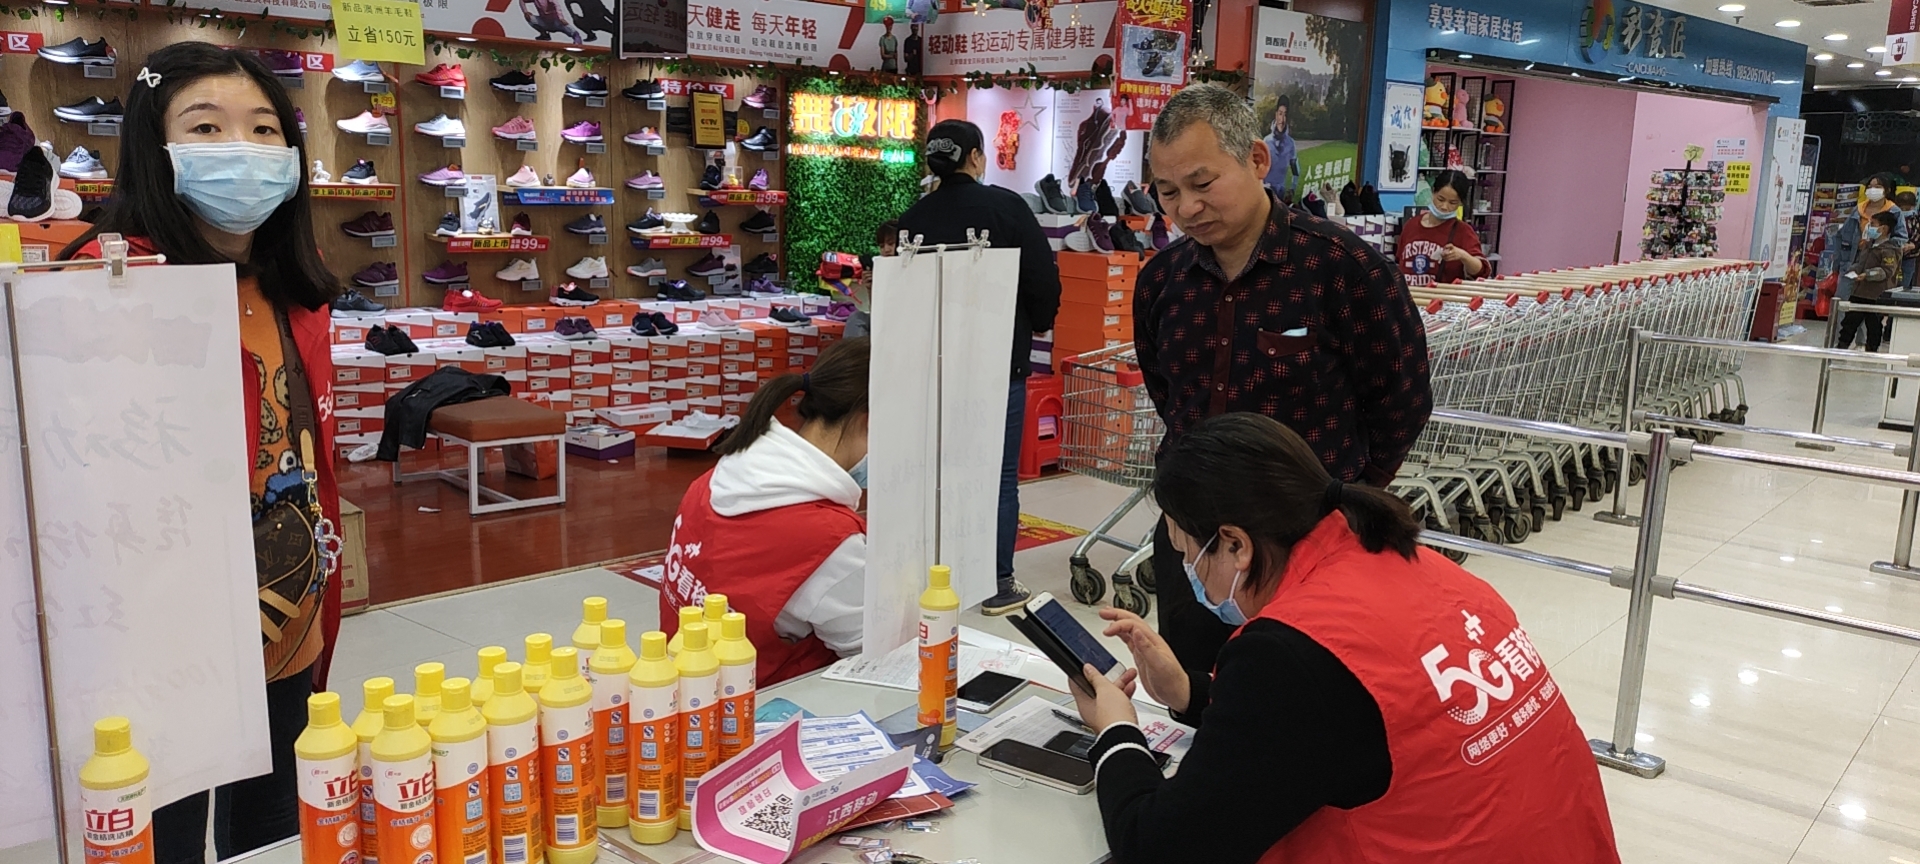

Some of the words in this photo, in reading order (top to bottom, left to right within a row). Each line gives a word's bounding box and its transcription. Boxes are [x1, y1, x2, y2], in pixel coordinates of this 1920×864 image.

[688, 4, 741, 31] 天健走
[751, 11, 817, 40] 每天年轻
[1428, 3, 1523, 43] 享受幸福家居生活
[1909, 0, 1919, 30] CASHIER
[347, 25, 416, 47] 立省150元
[928, 33, 968, 54] 轻动鞋
[971, 24, 1095, 53] 轻运动专属健身鞋
[1621, 5, 1687, 58] 彩瓷匠
[765, 193, 778, 203] 99
[474, 239, 509, 248] 新品上市
[521, 238, 538, 250] 99
[709, 236, 723, 246] 99
[1402, 241, 1440, 260] RSTBH
[1404, 274, 1436, 286] PRID
[1467, 722, 1510, 760] 网络更好
[1511, 696, 1542, 728] 服务更优
[324, 769, 359, 801] 立白
[397, 772, 434, 802] 立白
[85, 807, 134, 833] 立白
[826, 790, 878, 826] 江西移动
